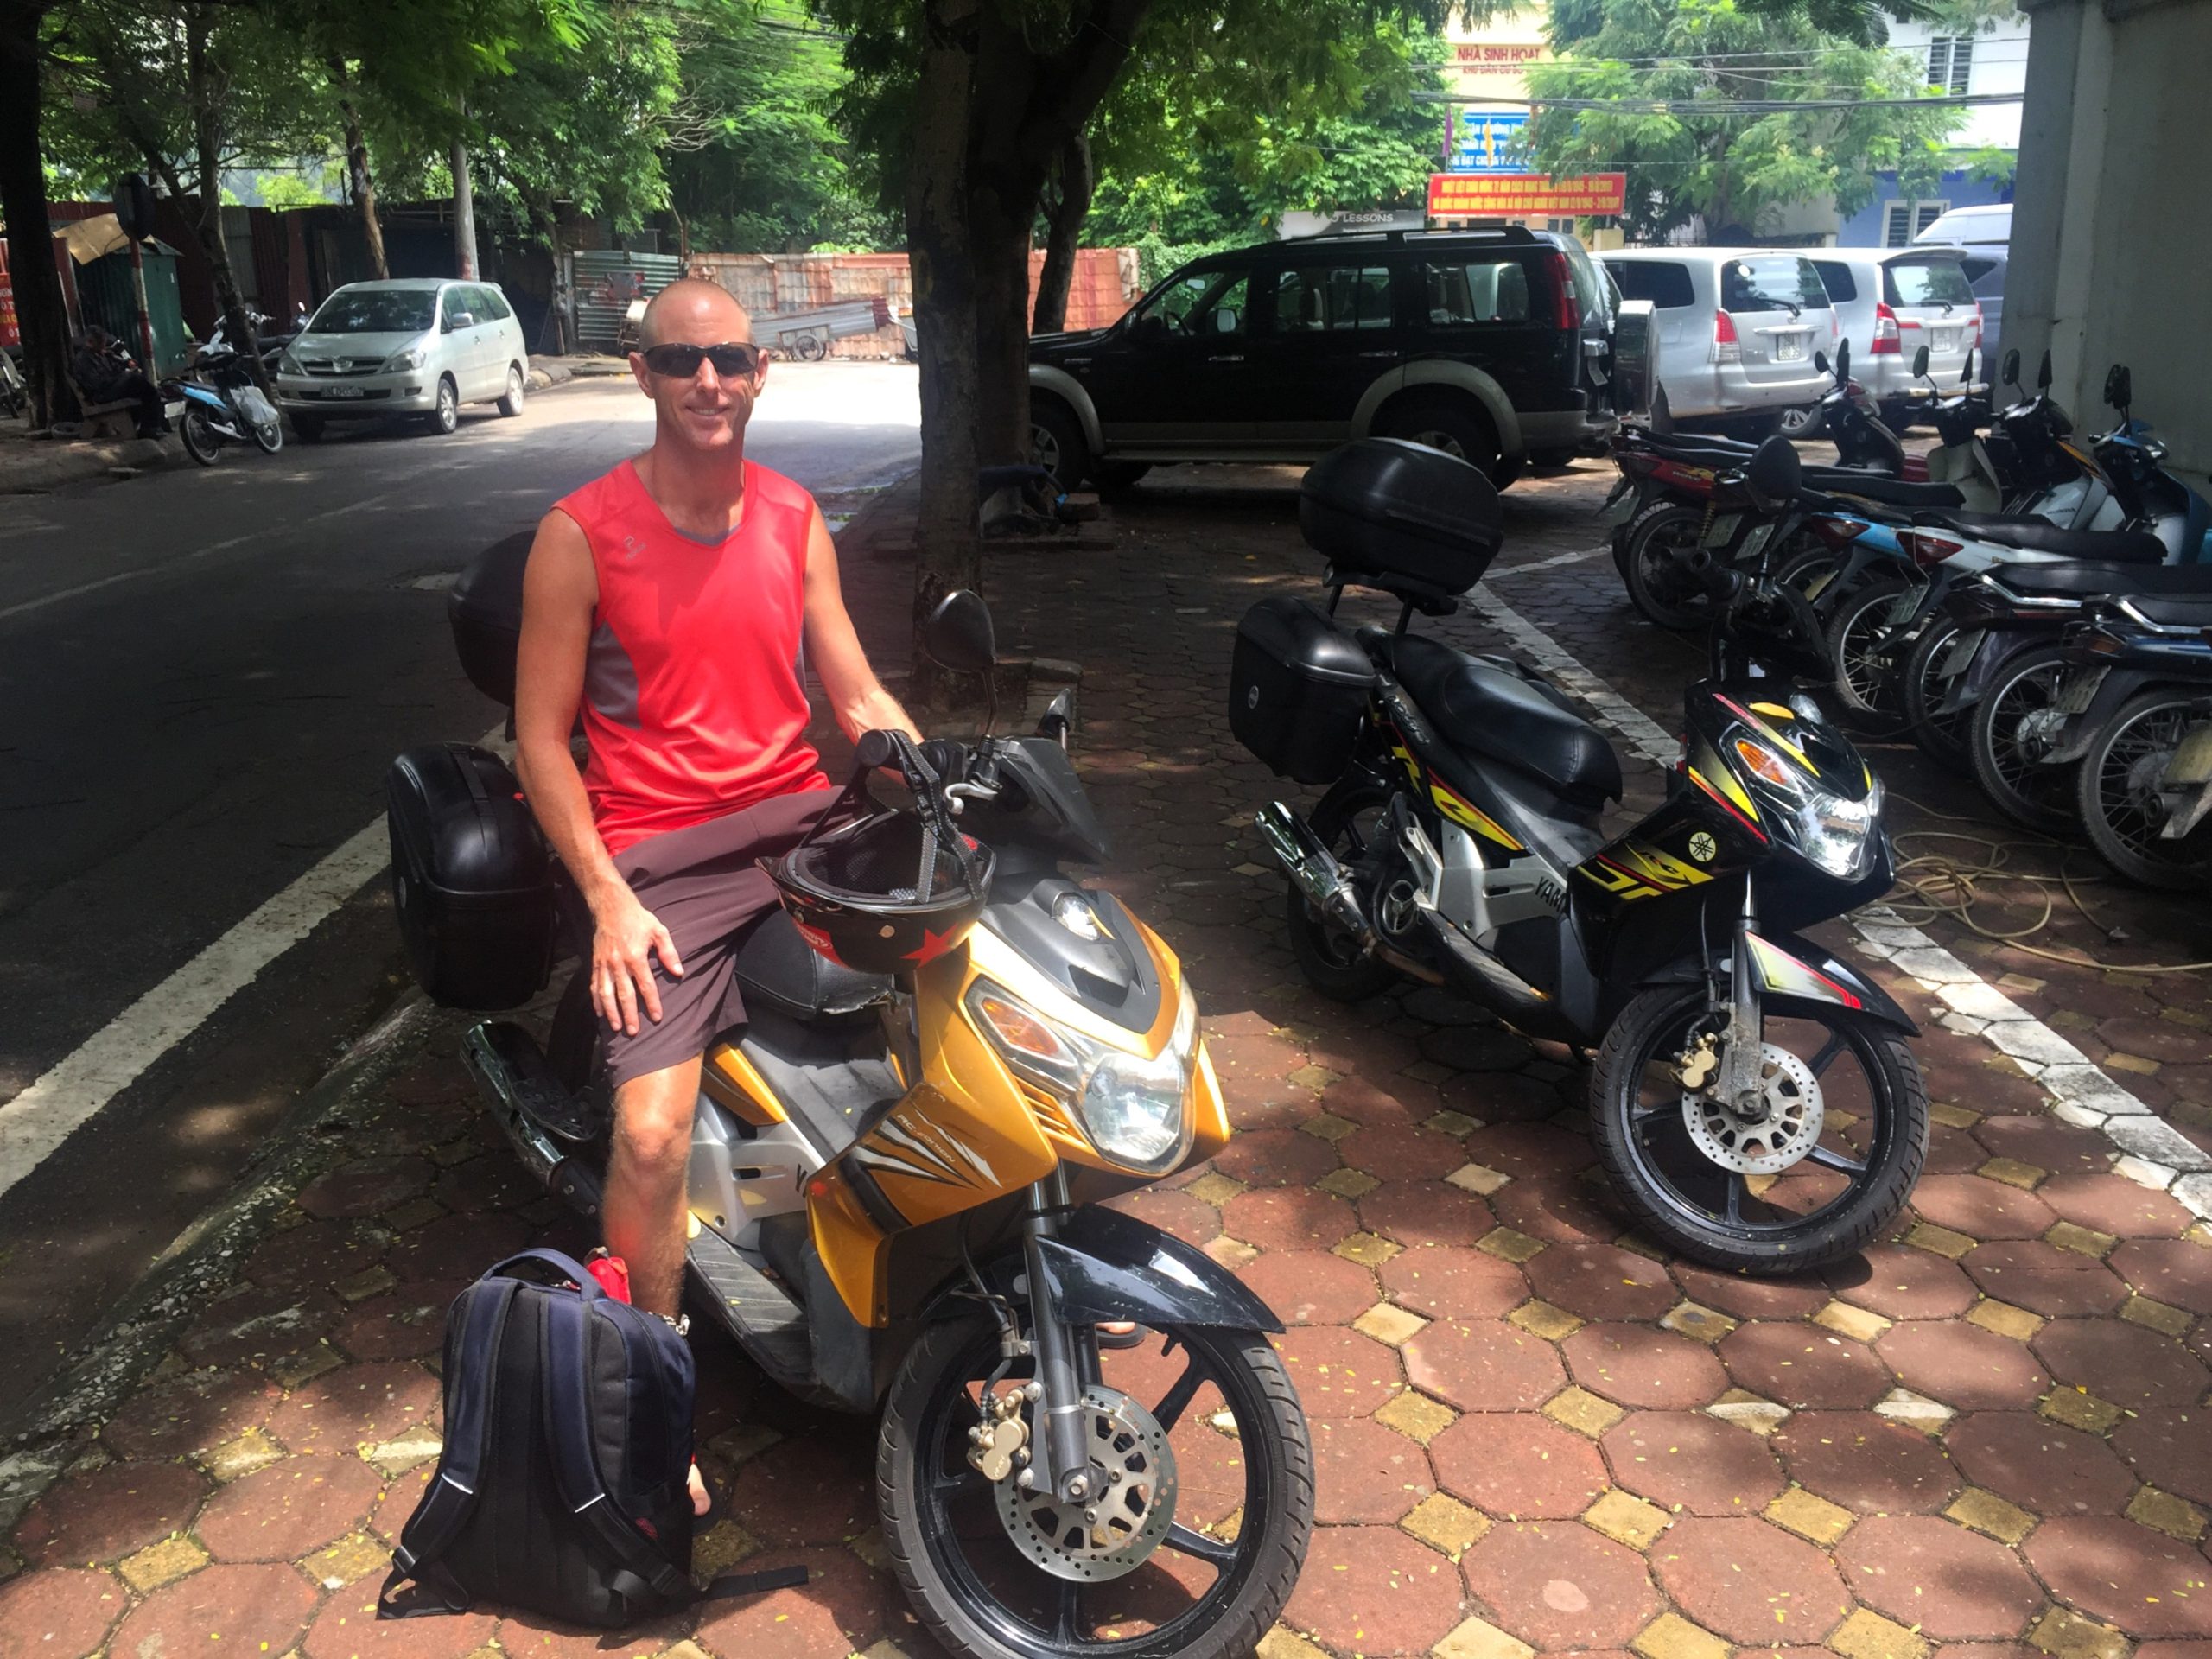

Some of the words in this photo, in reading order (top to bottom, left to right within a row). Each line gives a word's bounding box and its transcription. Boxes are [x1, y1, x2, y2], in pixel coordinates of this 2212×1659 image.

[1457, 44, 1481, 61] NHÀ
[1484, 47, 1509, 62] SINH
[1343, 213, 1395, 224] LESSONS
